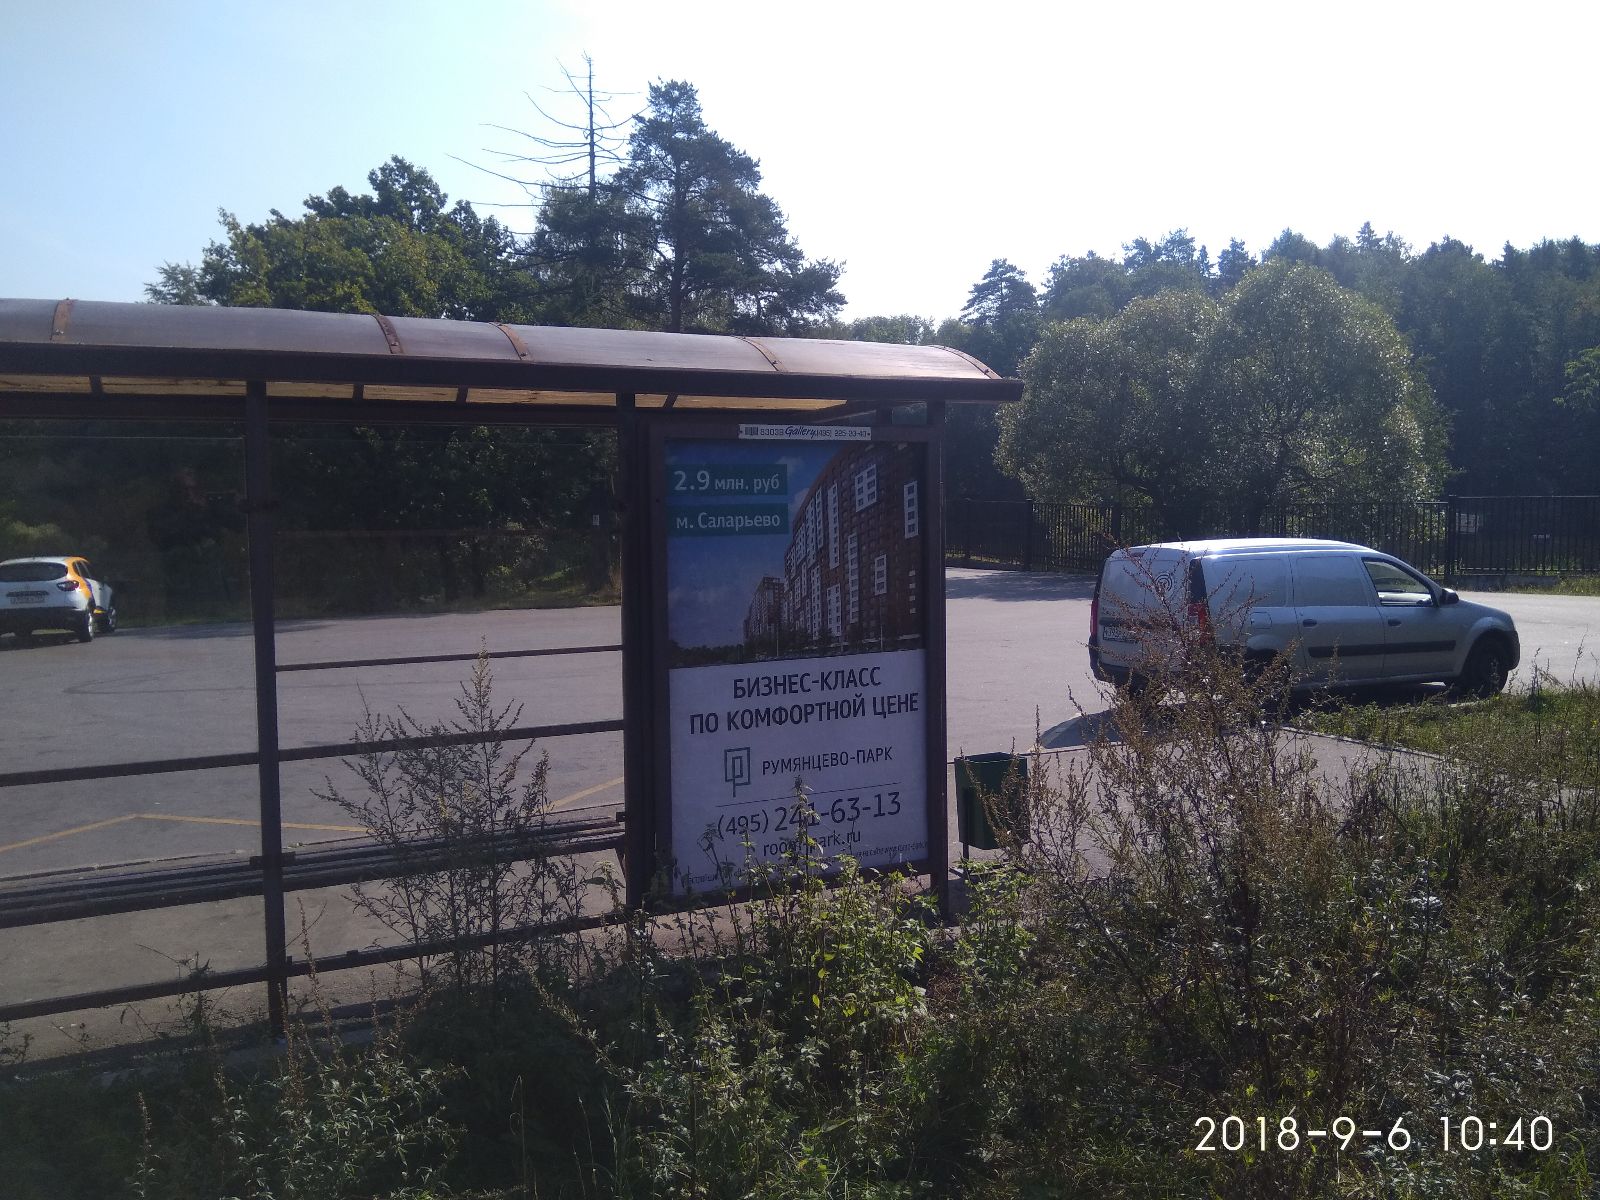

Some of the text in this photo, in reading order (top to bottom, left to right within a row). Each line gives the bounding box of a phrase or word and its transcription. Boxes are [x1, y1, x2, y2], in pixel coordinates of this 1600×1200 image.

[785, 426, 816, 439] Gallery
[674, 470, 780, 493] 2.9 млн. руб
[676, 512, 781, 532] м. Саларьево
[733, 666, 882, 699] БИЗНЕС-КЛАСС
[690, 692, 919, 735] ПО КОМФОРТНОЙ ЦЕНЕ
[762, 746, 893, 776] РУМЯНЦЕВО-ПАРК
[717, 791, 901, 842] (495) 241-63-13
